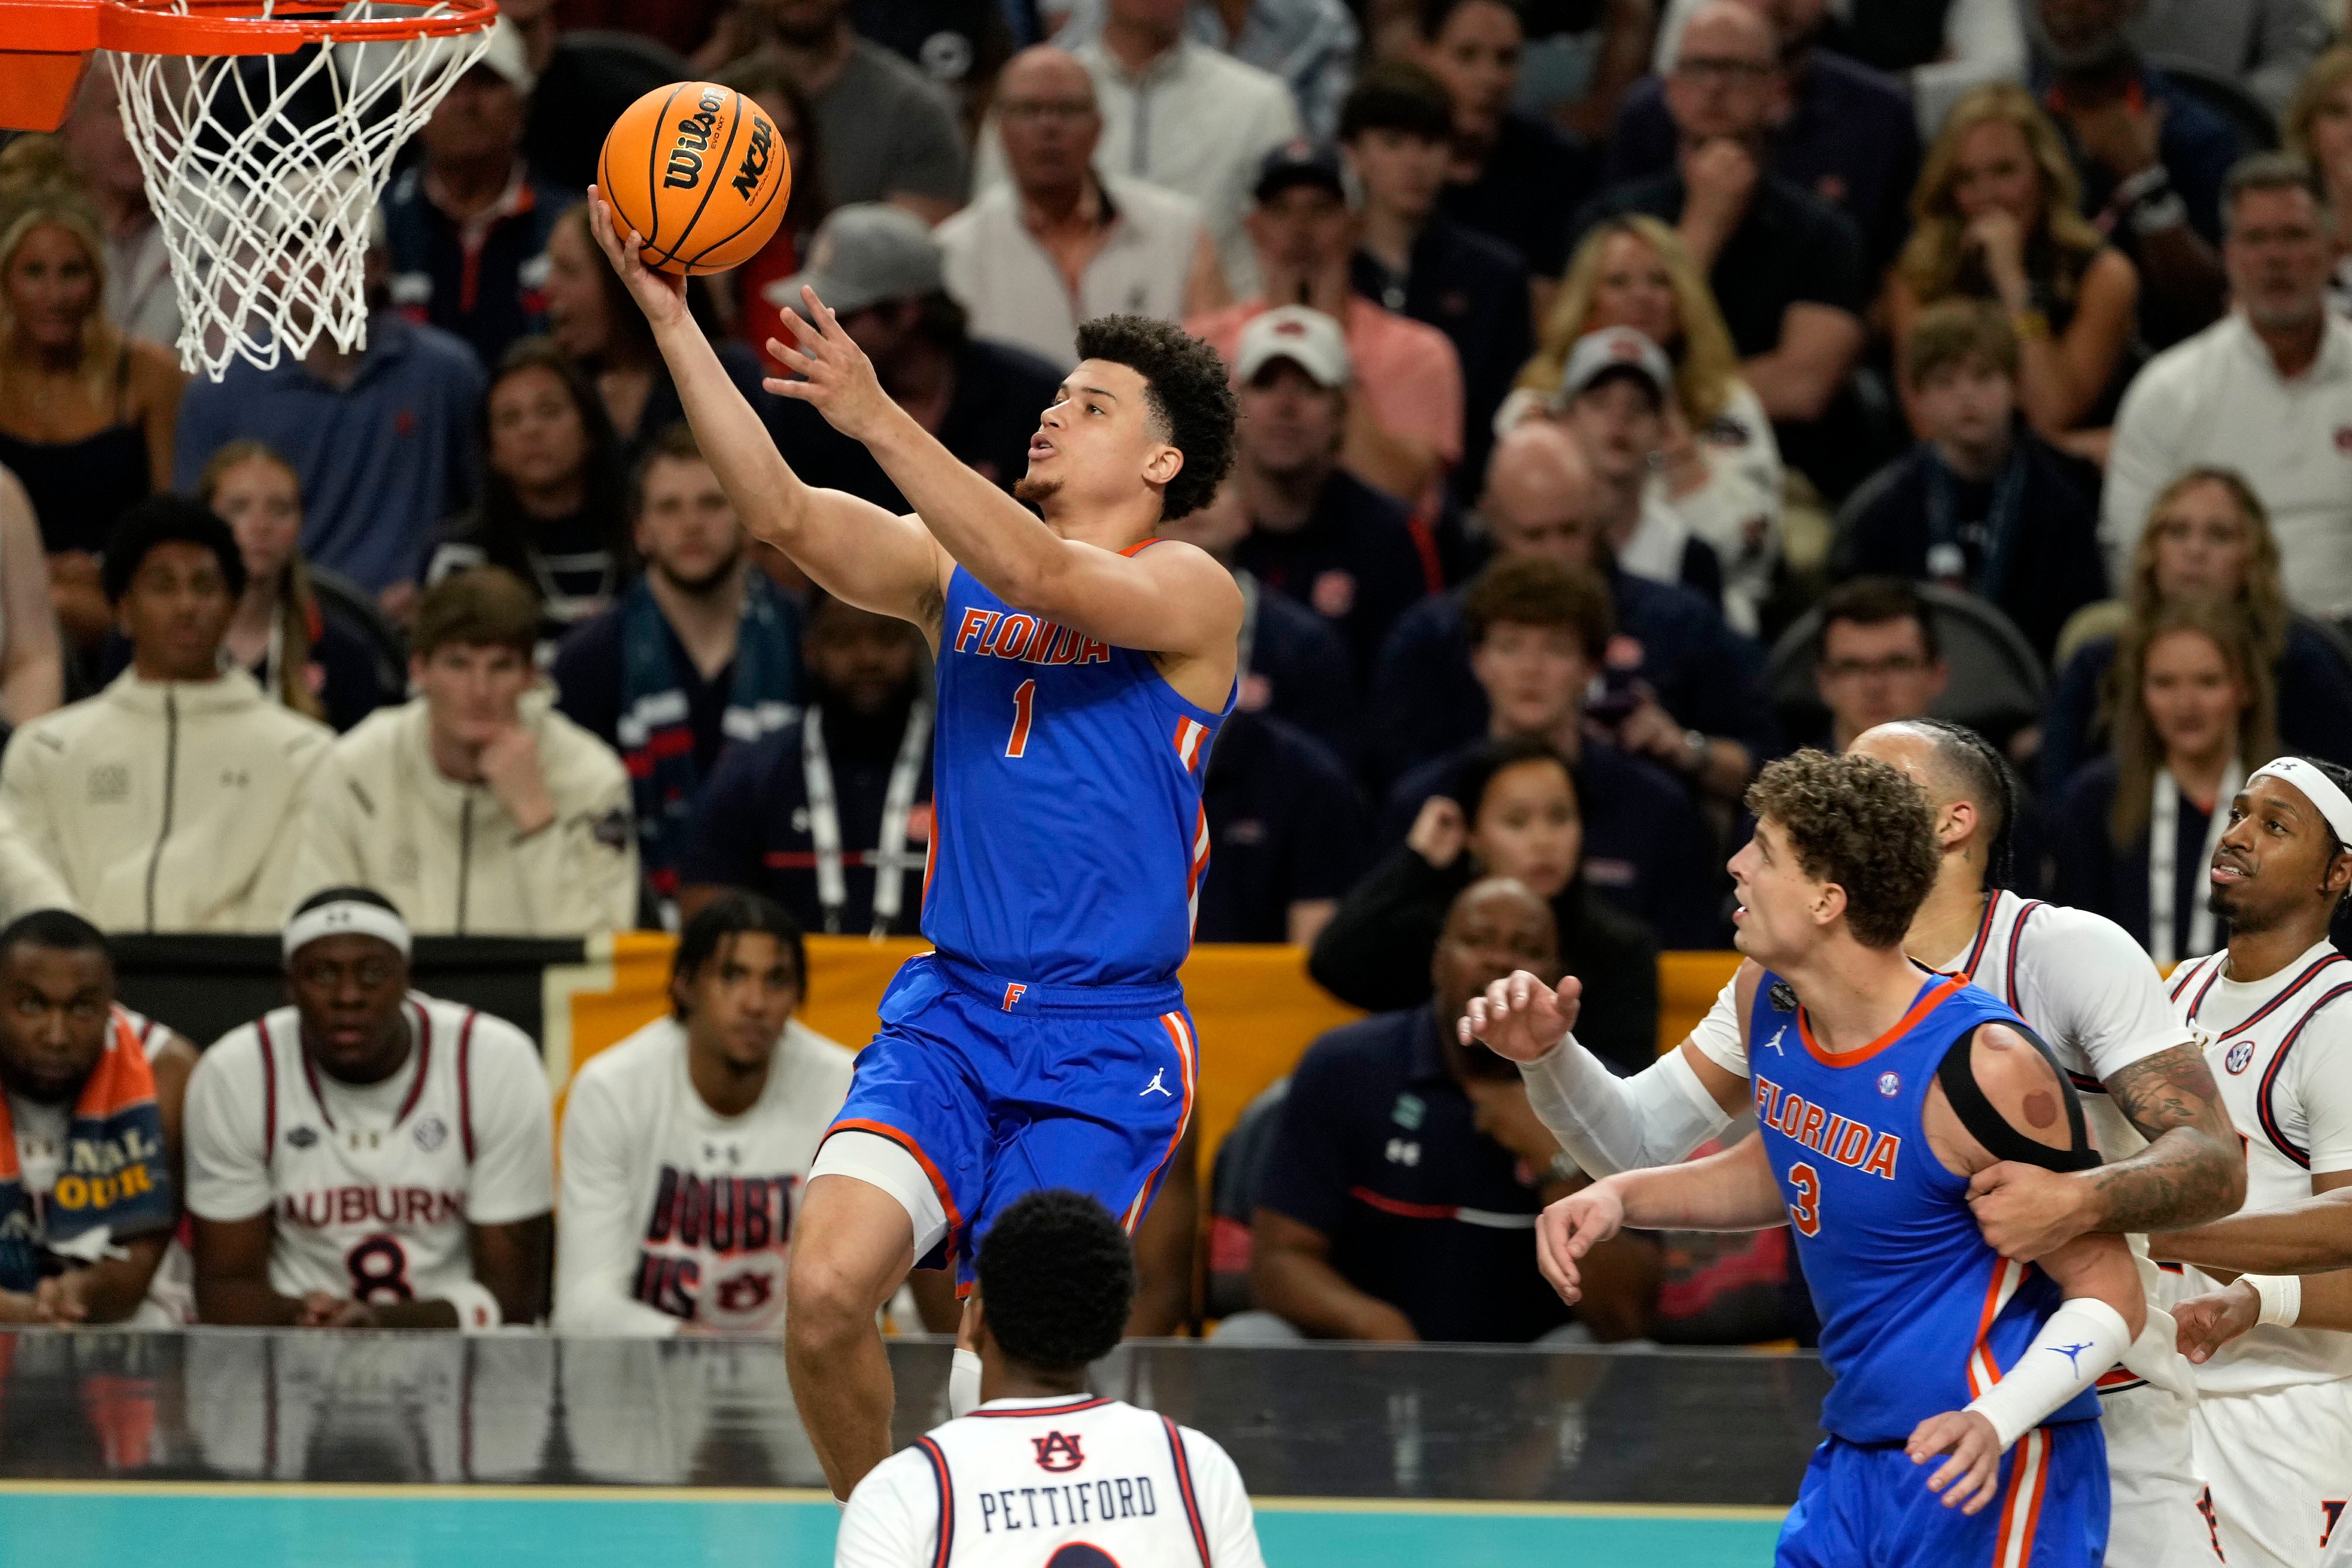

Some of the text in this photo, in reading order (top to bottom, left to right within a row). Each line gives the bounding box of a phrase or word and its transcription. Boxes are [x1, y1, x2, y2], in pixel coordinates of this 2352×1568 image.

[663, 87, 728, 189] Wilson
[711, 115, 725, 149] EVO NXT
[731, 115, 772, 203] NCAA
[1004, 678, 1035, 758] 1
[1001, 982, 1027, 1012] F
[1754, 1073, 1902, 1180] FLORIDA
[54, 1162, 154, 1211] OUR
[1788, 1161, 1821, 1238] 3
[346, 1231, 415, 1306] 8
[979, 1476, 1157, 1534] PETTIFORD
